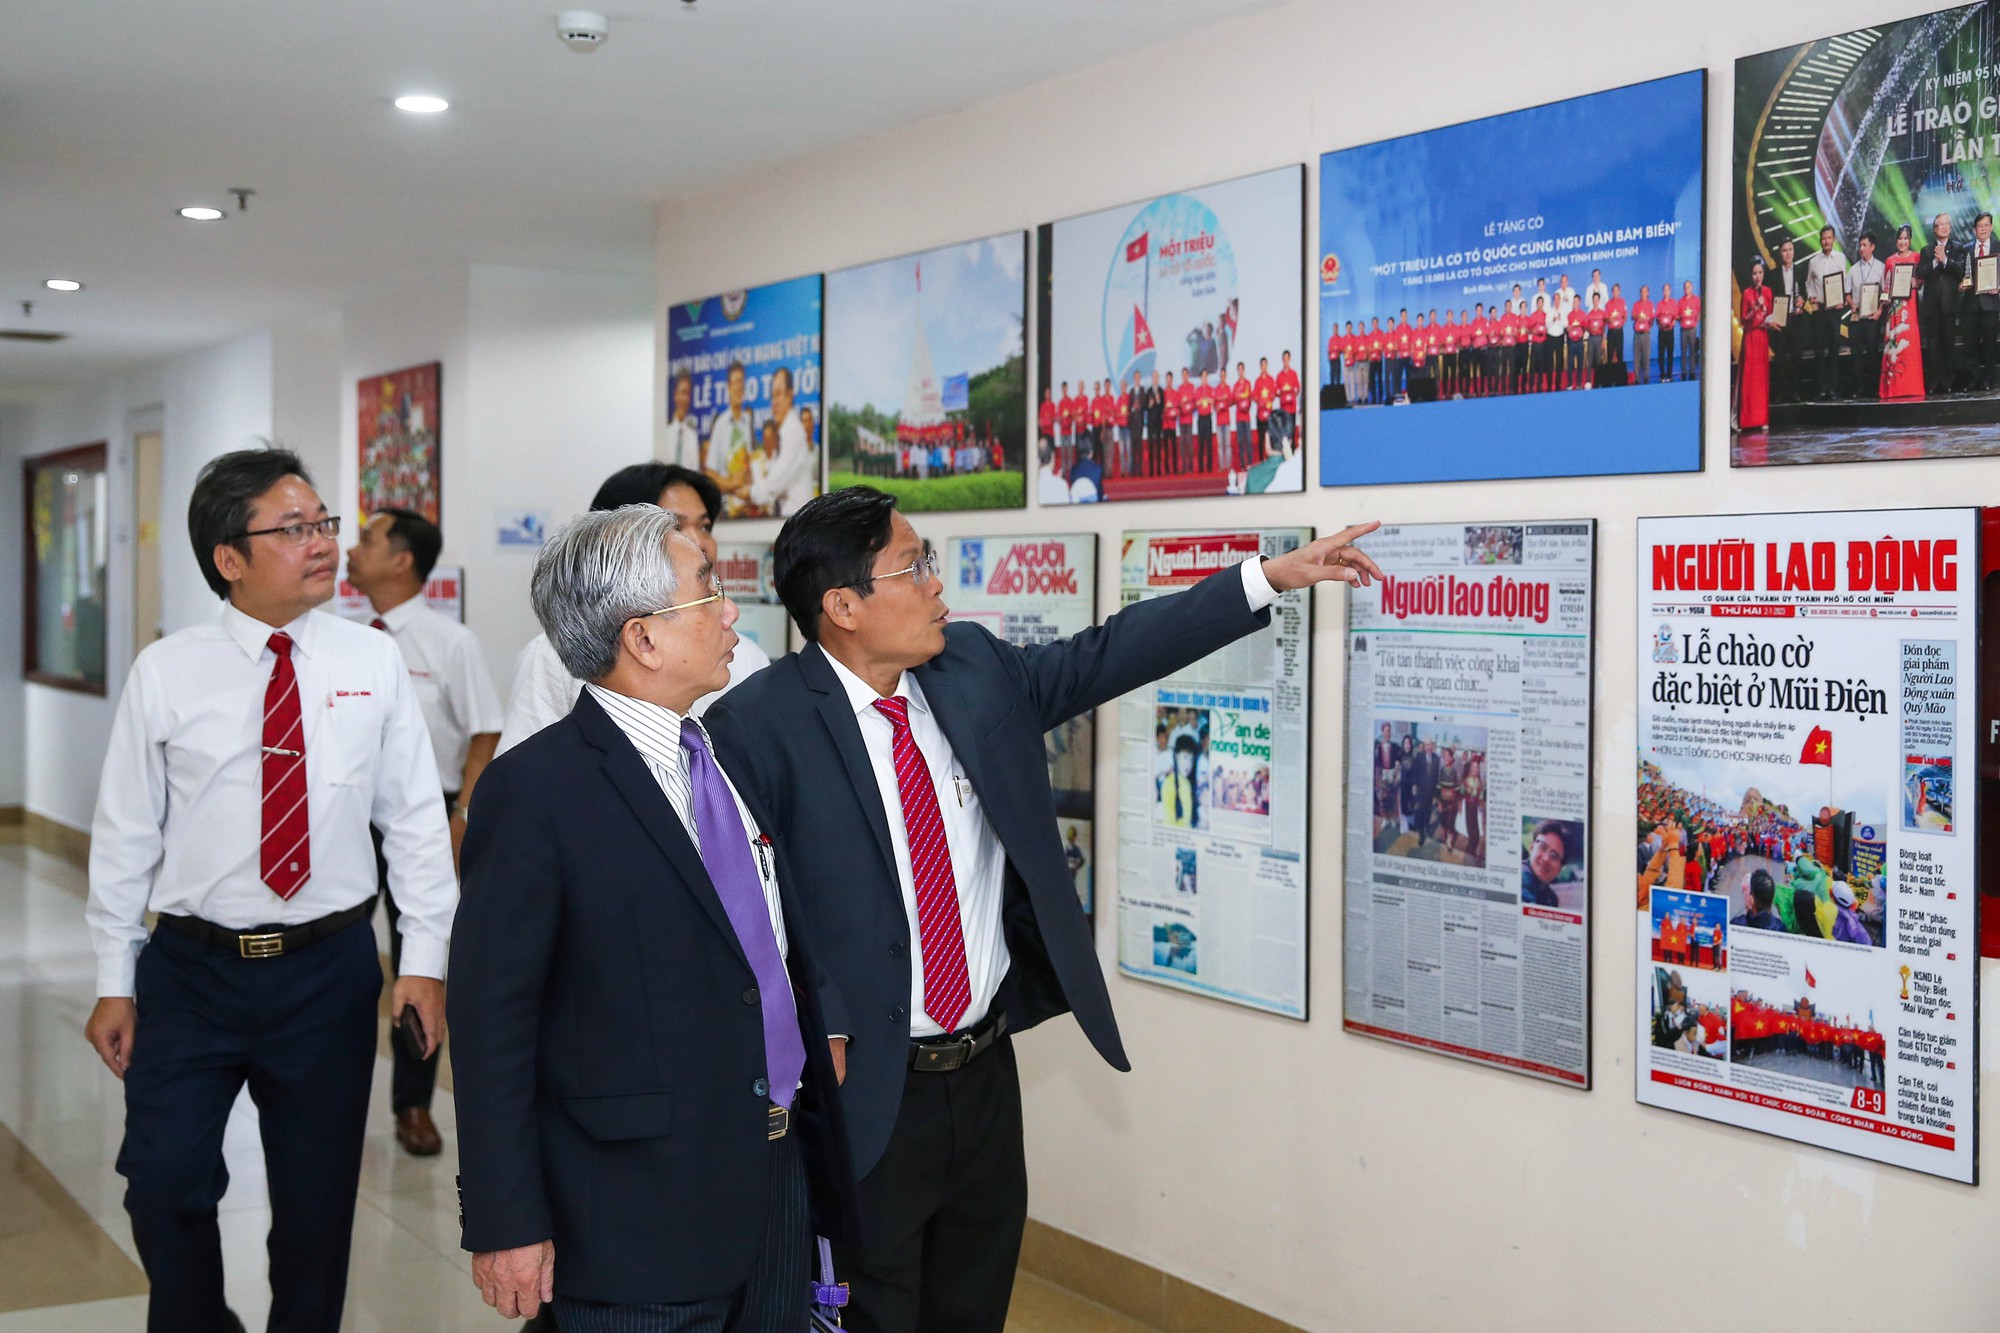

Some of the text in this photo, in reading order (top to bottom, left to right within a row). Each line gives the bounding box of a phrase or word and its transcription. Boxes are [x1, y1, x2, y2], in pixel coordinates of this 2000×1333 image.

[1944, 69, 1972, 88] NIỆM
[1975, 66, 1990, 80] 95
[1887, 103, 1907, 137] LỄ
[1914, 101, 1972, 132] TRAO
[1941, 129, 1984, 166] LẦN
[1482, 244, 1517, 263] QUỐC
[1010, 539, 1066, 568] NGƯỜI
[1150, 545, 1194, 576] Người
[1195, 544, 1218, 569] lao
[1652, 534, 1957, 595] NGƯỜI LAO ĐỘNG
[1380, 575, 1549, 624] Người lao động
[1858, 595, 1871, 603] CHÍ
[1720, 605, 1741, 614] THỨ
[1743, 606, 1762, 614] HAI
[1682, 628, 1814, 669] Lễ chào cờ
[1904, 644, 1941, 659] Đón đọc
[1446, 652, 1465, 673] việc
[1496, 654, 1520, 673] khai
[1903, 658, 1920, 672] giai
[1426, 676, 1451, 693] quan
[1903, 673, 1953, 686] Người Lao
[1653, 671, 1889, 722] đặc biệt ở Mũi Điện
[1903, 687, 1954, 701] Động xuân
[1904, 702, 1946, 716] Quý Mão
[1916, 864, 1933, 875] công
[1935, 864, 1943, 874] 12
[1910, 874, 1918, 883] án
[1920, 876, 1932, 885] cao
[1934, 877, 1946, 887] tốc
[1920, 886, 1935, 897] Nam
[1899, 909, 1908, 918] TP
[1909, 910, 1925, 921] HCM
[1939, 926, 1956, 939] dung
[1899, 932, 1941, 948] học sinh giai
[1914, 971, 1932, 982] NSND
[1934, 985, 1947, 996] Biết
[1939, 998, 1951, 1008] đọc
[1915, 1041, 1932, 1053] GTGT
[1934, 1046, 1947, 1056] cho
[1898, 1050, 1944, 1069] doanh nghiệp
[1927, 1082, 1938, 1092] coi
[1857, 1089, 1882, 1112] 8-9
[1898, 1099, 1919, 1111] chiếm
[1898, 1110, 1915, 1124] trong
